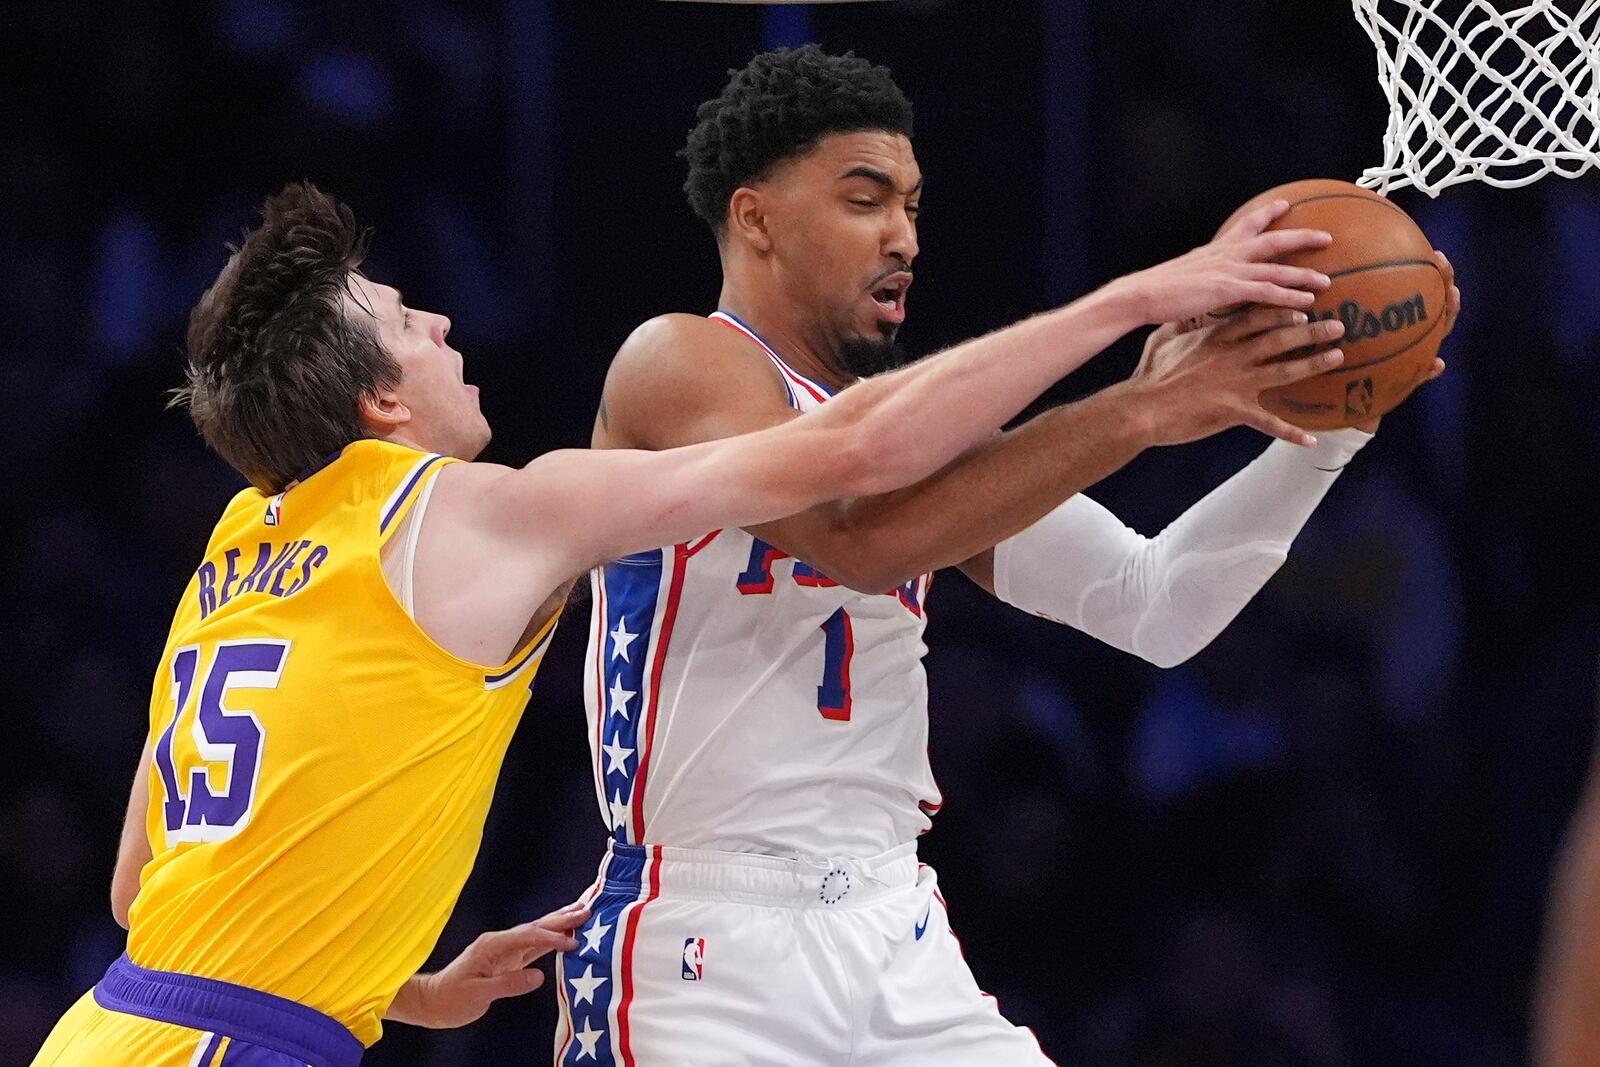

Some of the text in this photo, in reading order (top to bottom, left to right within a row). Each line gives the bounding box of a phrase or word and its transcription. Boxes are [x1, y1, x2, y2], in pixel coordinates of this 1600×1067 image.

[197, 540, 329, 621] REAVES
[816, 606, 855, 721] 1
[154, 639, 292, 848] 15
